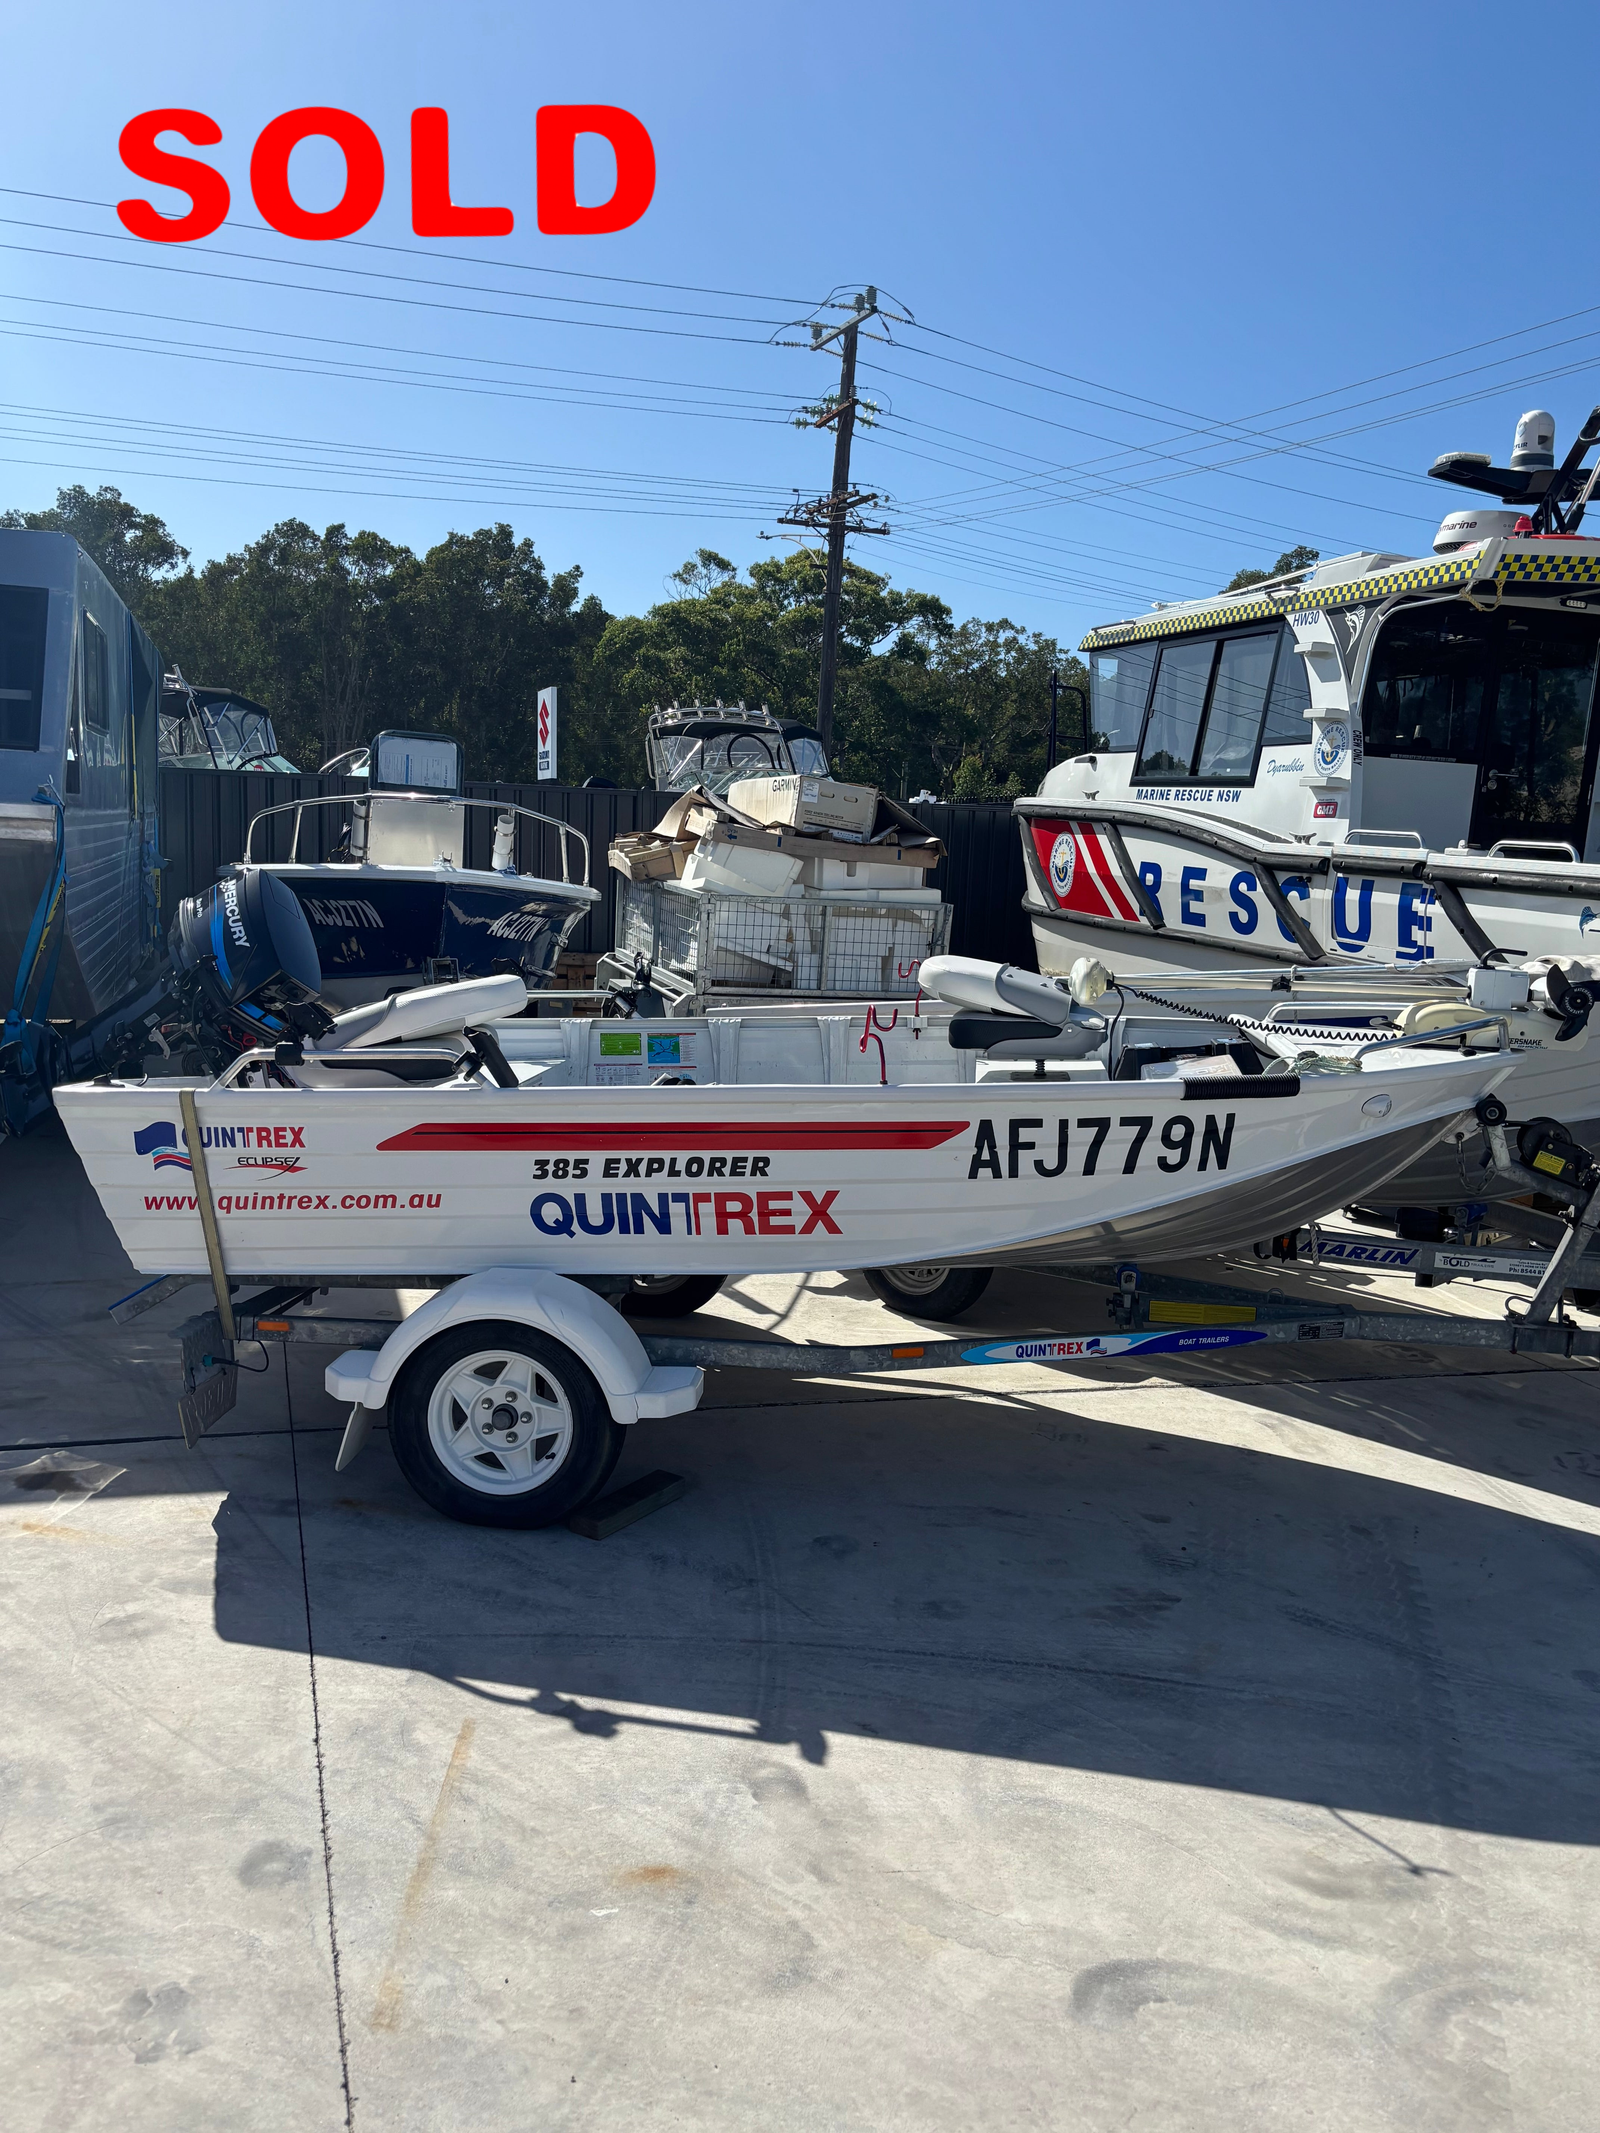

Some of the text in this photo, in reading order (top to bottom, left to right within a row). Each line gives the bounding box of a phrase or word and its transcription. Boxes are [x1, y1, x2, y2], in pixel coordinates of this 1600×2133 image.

[1292, 610, 1321, 628] HW30
[1352, 729, 1363, 767] CREW ONLY
[771, 778, 798, 792] GARMIN
[1136, 788, 1242, 803] MARINE RESCUE NSW
[1316, 805, 1335, 815] GME
[224, 879, 251, 948] MERCURY
[303, 898, 385, 928] ACJ277N
[1138, 861, 1437, 961] RESCUE
[486, 911, 549, 942] ACJ277N
[968, 1112, 1236, 1180] AFJ779N
[237, 1156, 297, 1166] ECLIPSE
[532, 1156, 771, 1179] 385 EXPLORER
[144, 1191, 443, 1214] wwwquintrex.com.au
[529, 1189, 844, 1239] QUINTREX
[1298, 1240, 1420, 1265] MARLIN
[1443, 1257, 1471, 1268] BOLD
[1016, 1335, 1230, 1359] QUINTREX BOAT TRAILERS
